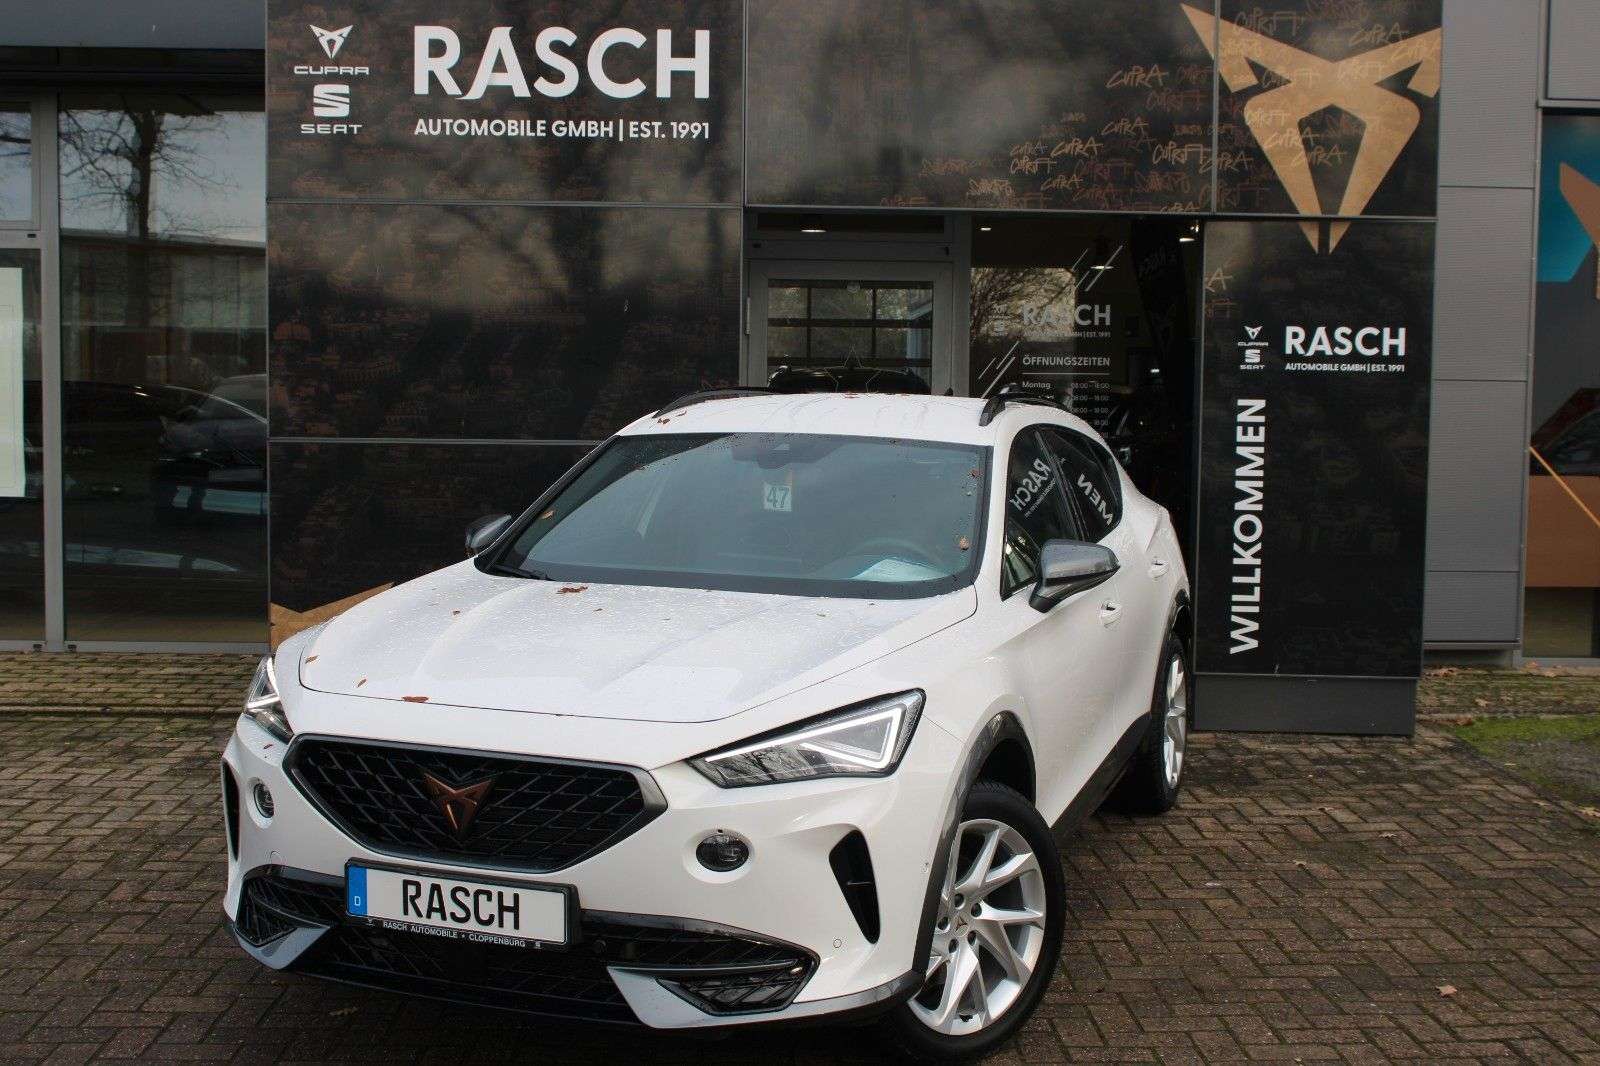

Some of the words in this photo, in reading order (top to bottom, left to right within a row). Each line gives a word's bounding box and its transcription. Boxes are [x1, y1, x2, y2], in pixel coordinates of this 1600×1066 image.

[294, 66, 369, 75] CUPRA
[413, 25, 710, 100] RASCH
[300, 124, 362, 135] SEAT
[414, 118, 546, 138] AUTOMOBILE
[551, 120, 614, 138] GMBH
[628, 121, 666, 138] EST.
[671, 122, 710, 139] 1991
[1284, 326, 1406, 356] RASCH
[1022, 354, 1111, 367] ÖFFNUNGSZEITEN
[1285, 363, 1340, 371] AUTOMOBILE
[1341, 364, 1367, 372] GMBH
[1389, 364, 1406, 372] 1991
[1022, 381, 1051, 390] Montag
[766, 486, 790, 508] 47
[1229, 399, 1266, 655] WILLKOMMEN
[354, 896, 361, 906] D
[402, 879, 520, 930] RASCH
[383, 921, 408, 933] RASCH
[410, 925, 458, 938] AUTOMOBILE
[469, 934, 526, 948] CLOPPENBURG
